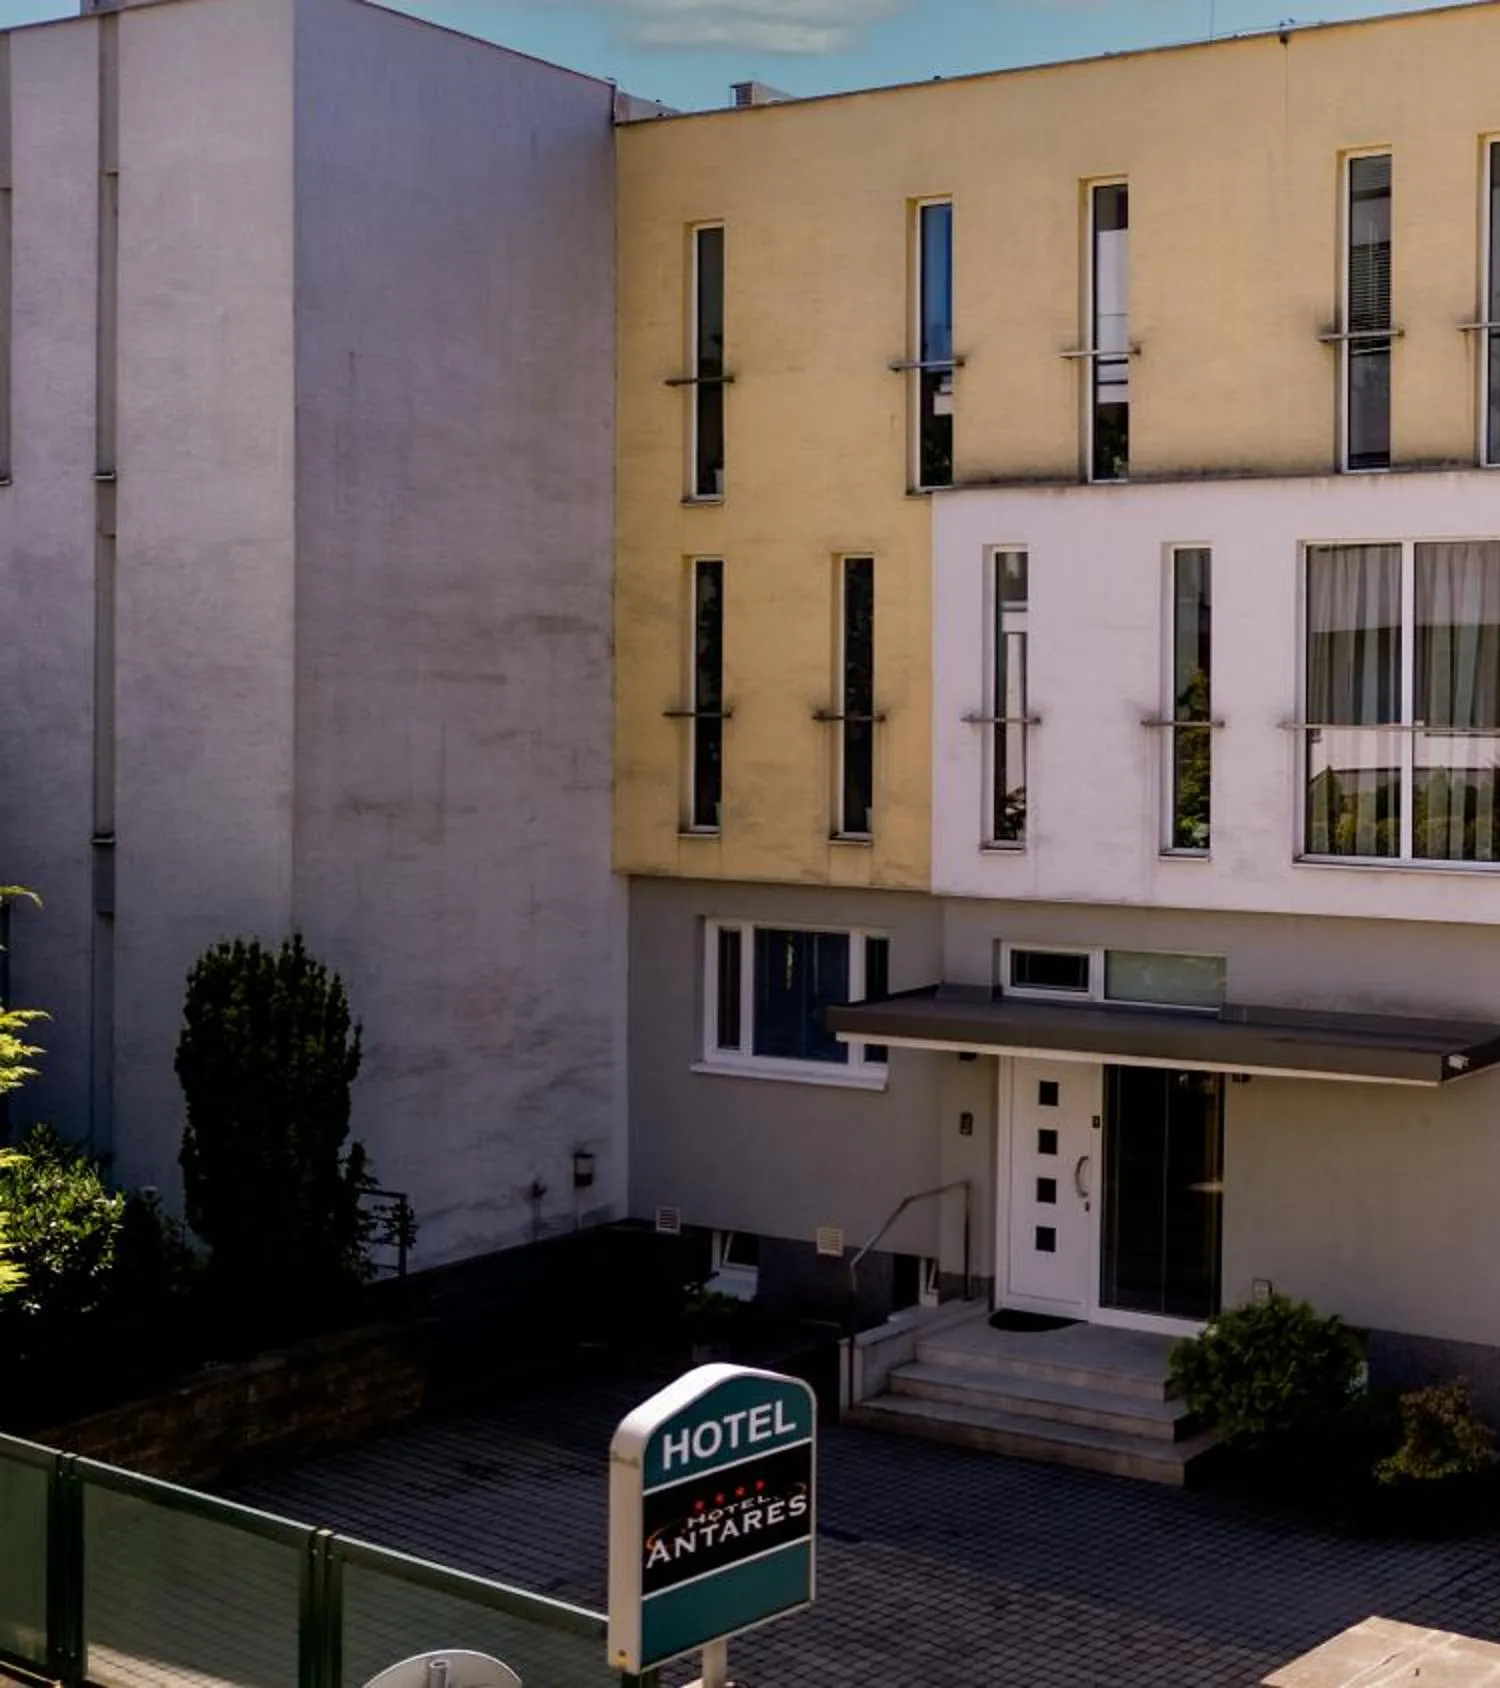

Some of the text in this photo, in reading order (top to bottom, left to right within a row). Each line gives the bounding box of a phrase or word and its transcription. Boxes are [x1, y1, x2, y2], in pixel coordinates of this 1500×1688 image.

[662, 1400, 797, 1470] HOTEL
[646, 1494, 807, 1568] ANTARES
[687, 1495, 771, 1528] HOTEL
